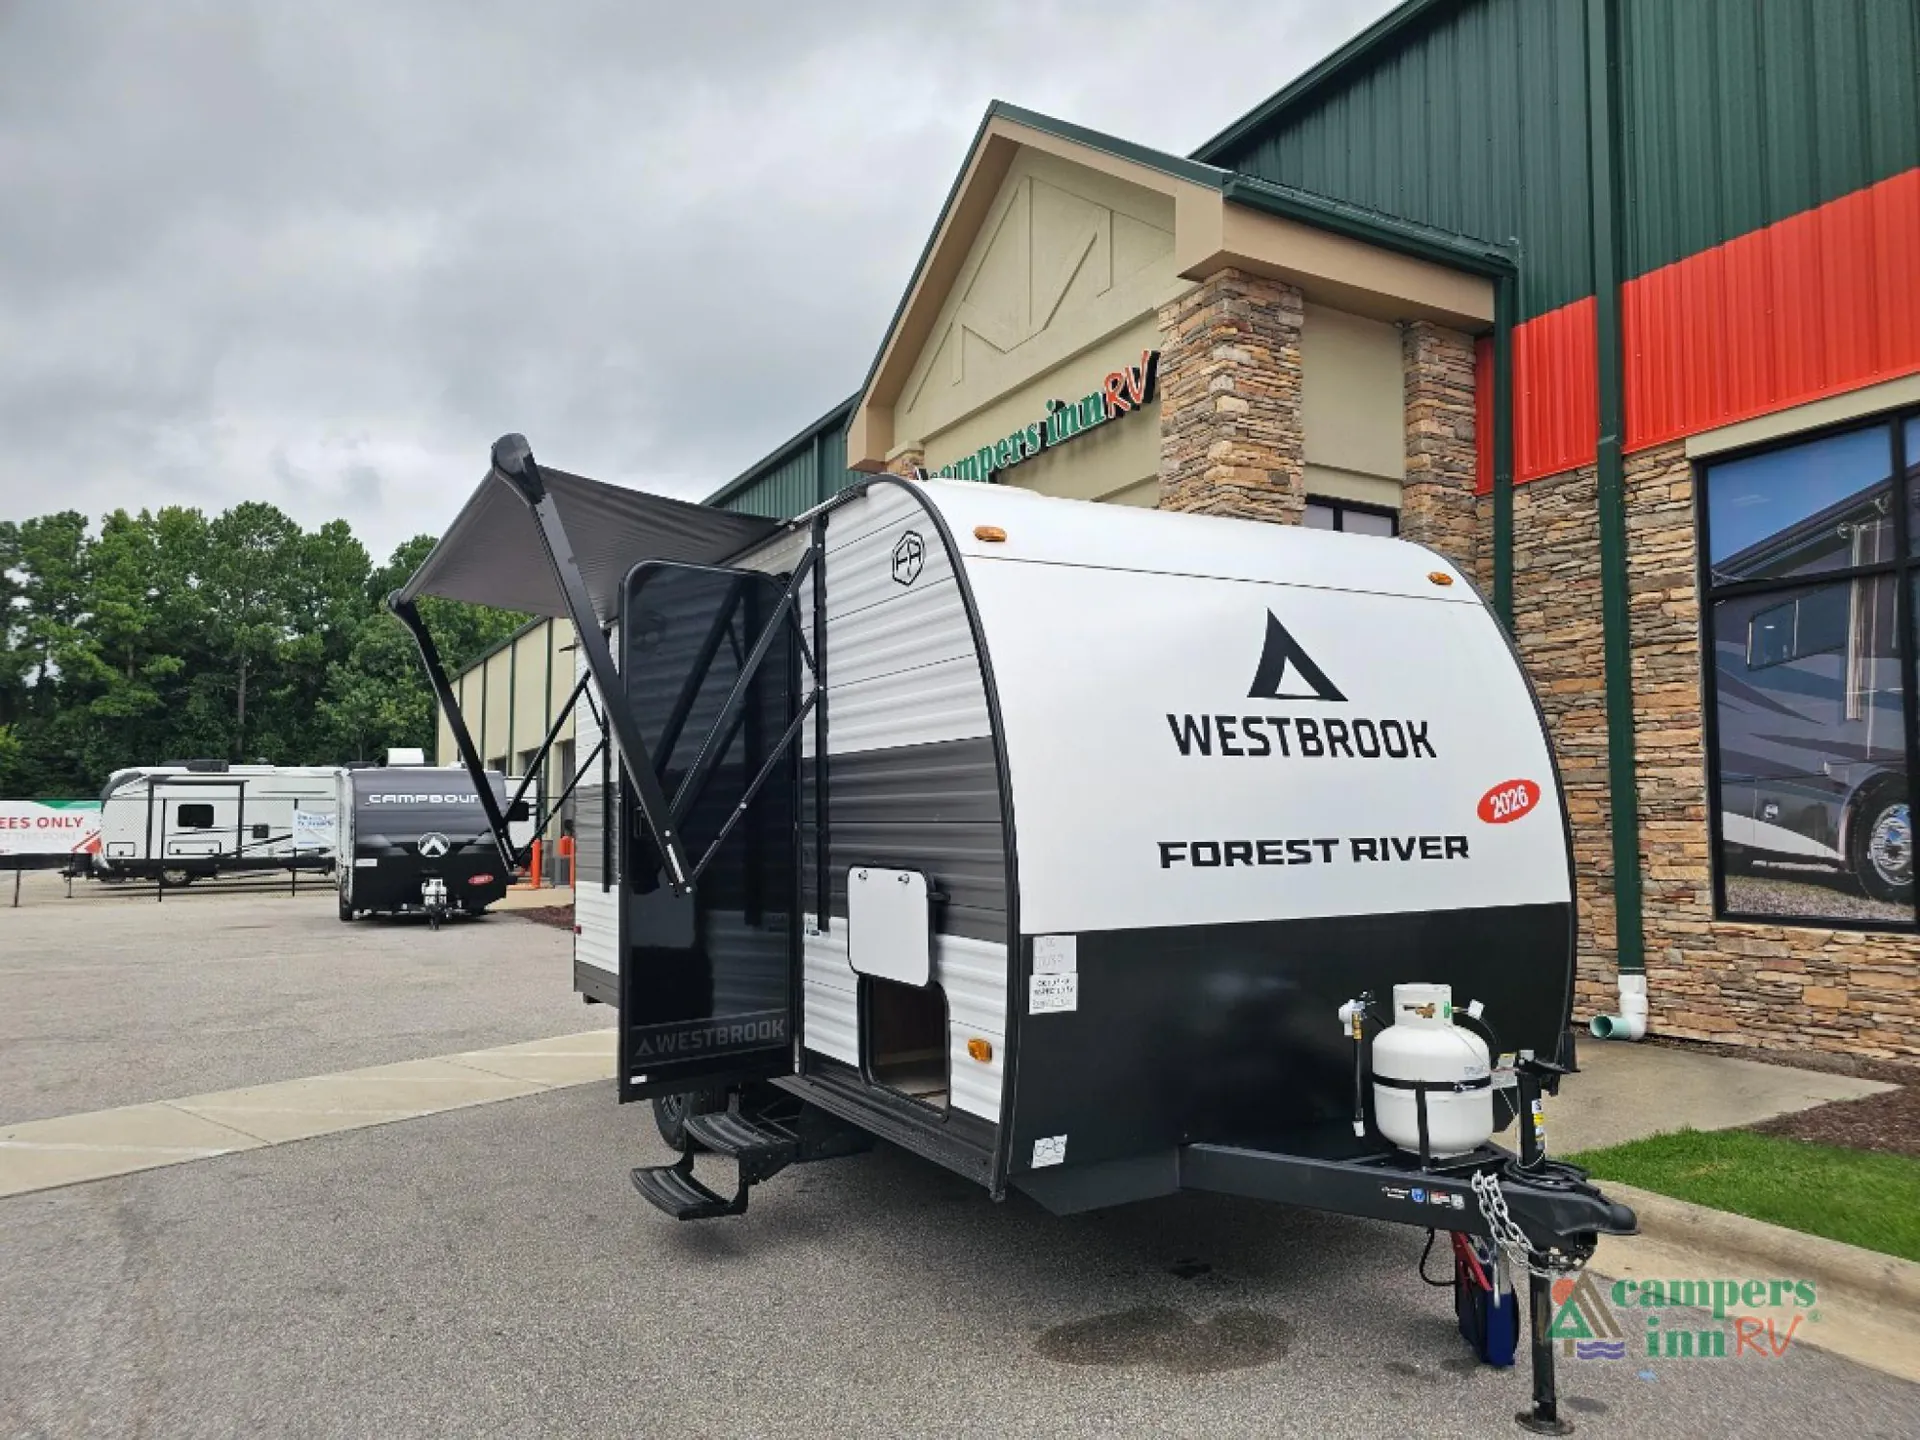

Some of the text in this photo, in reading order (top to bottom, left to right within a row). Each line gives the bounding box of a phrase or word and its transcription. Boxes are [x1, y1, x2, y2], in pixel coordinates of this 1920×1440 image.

[1045, 391, 1106, 446] inn
[1103, 348, 1152, 419] RV
[1166, 713, 1437, 759] WESTBROOK
[1490, 784, 1529, 820] 2026
[36, 816, 84, 829] ONLY
[1157, 835, 1470, 869] FOREST RIVER
[655, 1019, 785, 1053] WESTBROOK
